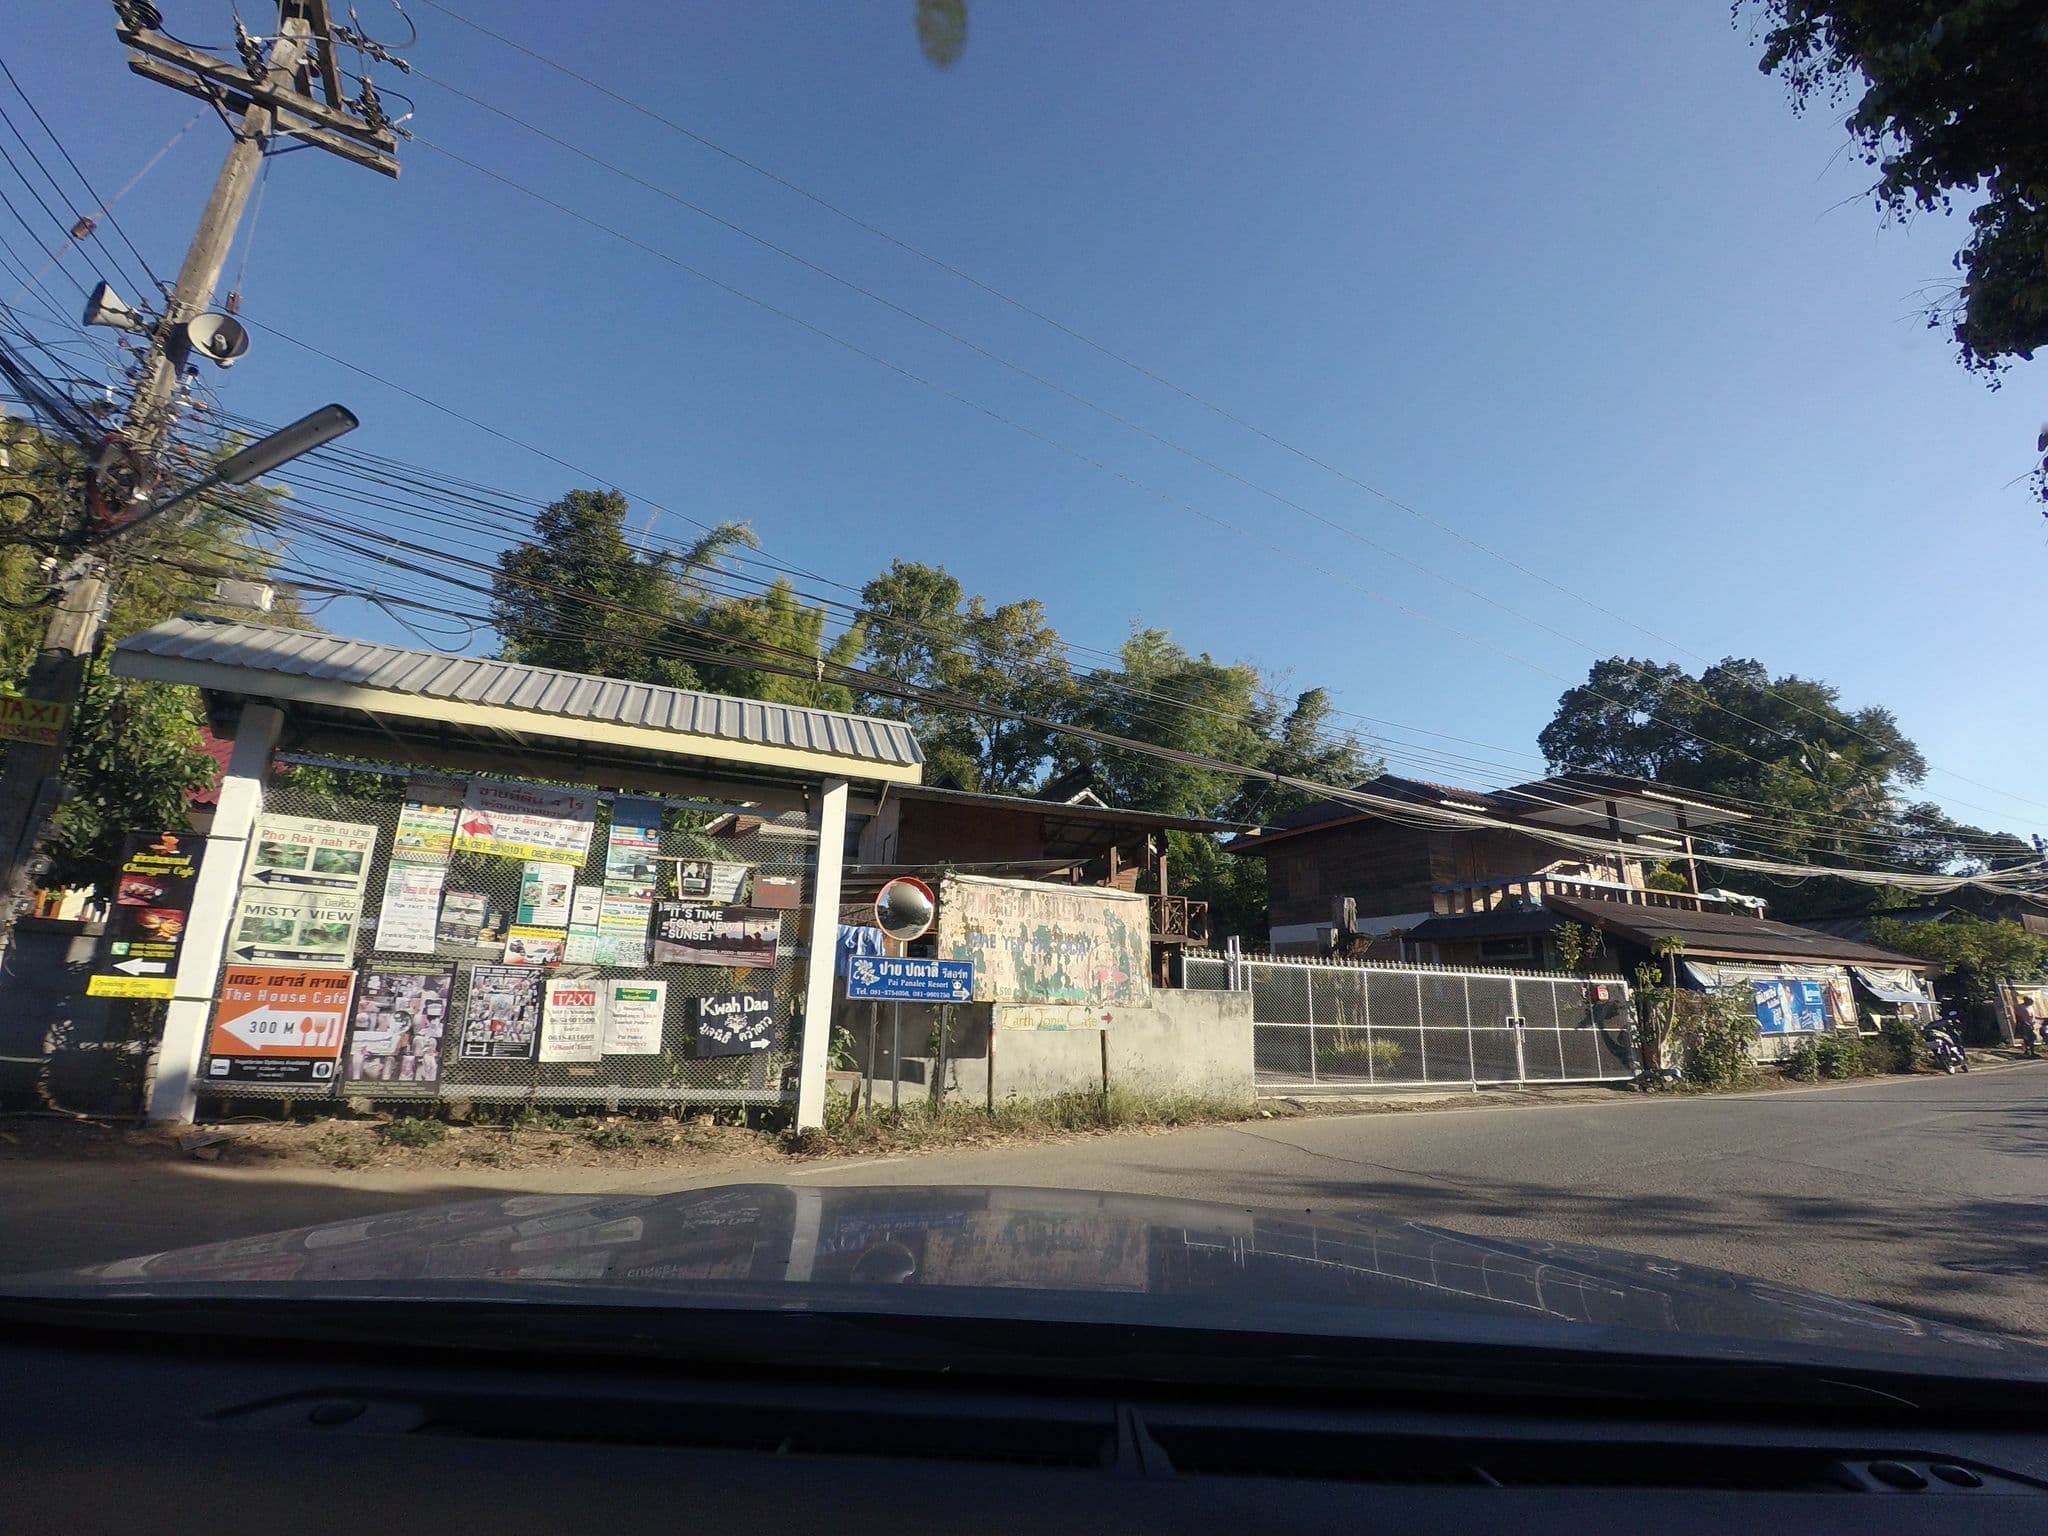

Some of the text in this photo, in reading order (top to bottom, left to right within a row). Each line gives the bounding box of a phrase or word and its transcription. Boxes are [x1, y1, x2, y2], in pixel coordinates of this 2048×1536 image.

[496, 824, 508, 833] For
[513, 827, 530, 837] Sale
[291, 833, 315, 845] Rak
[320, 837, 343, 847] nah
[349, 839, 368, 851] Pai
[244, 904, 354, 922] MISTY VIEW
[669, 907, 723, 920] IT'S TIME
[668, 918, 734, 932] FOR A NEW
[667, 930, 714, 942] SUNSET
[879, 960, 902, 977] ปาย
[942, 967, 968, 979] รีสอร์ท
[227, 973, 263, 986] เดอะ
[267, 972, 308, 988] เฮาส์
[887, 978, 948, 989] Pai Panalee Resort
[224, 987, 348, 1006] The House Café
[555, 993, 593, 1005] TAXI
[700, 995, 769, 1017] Kwah Dao
[1002, 1008, 1034, 1029] Earth
[1067, 1007, 1097, 1028] Cafe
[248, 1021, 296, 1037] 300 M
